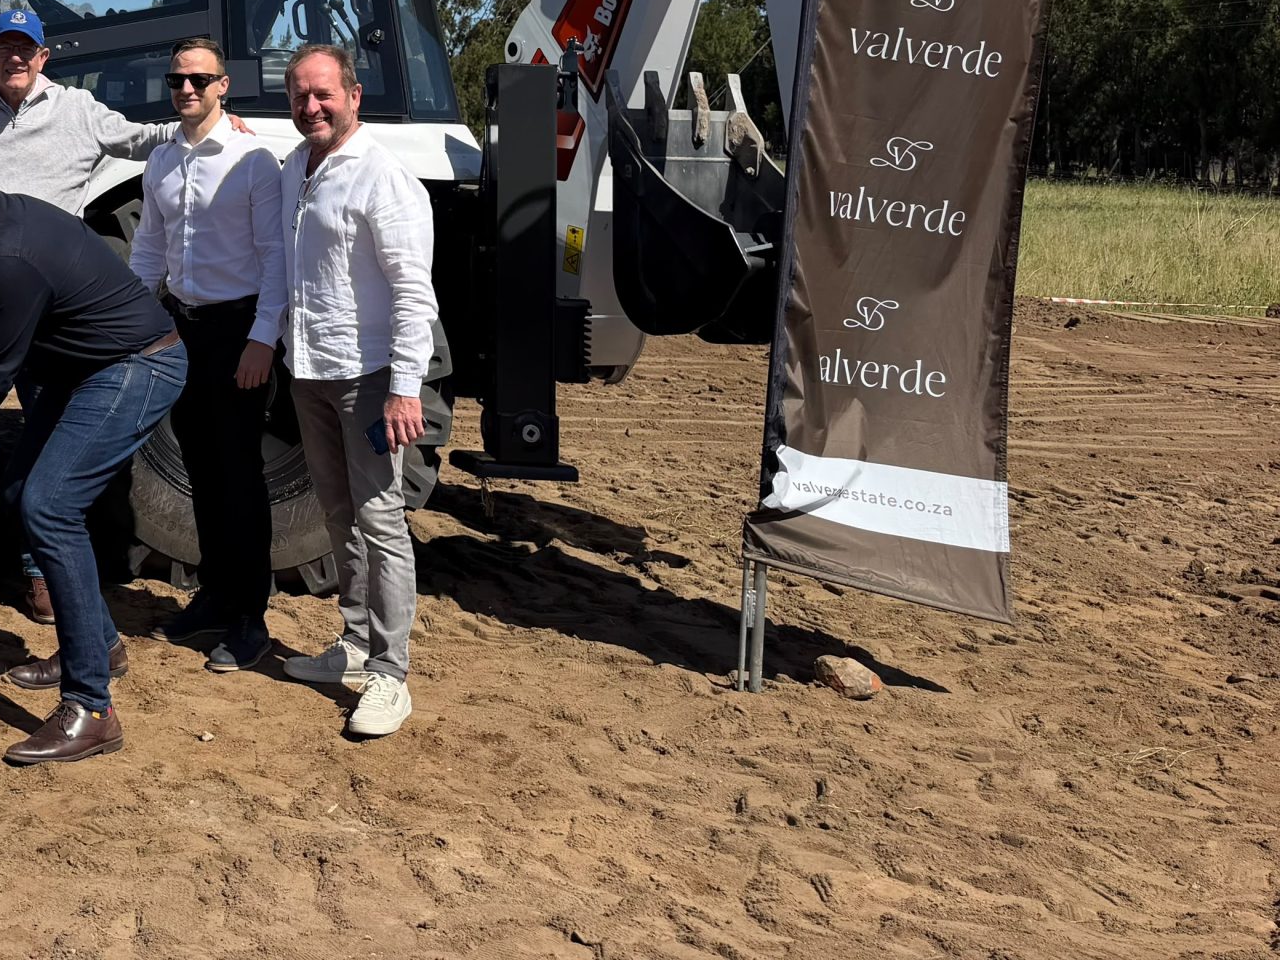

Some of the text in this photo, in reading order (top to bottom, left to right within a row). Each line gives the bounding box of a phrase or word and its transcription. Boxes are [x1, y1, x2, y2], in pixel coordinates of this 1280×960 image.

[850, 27, 1003, 78] valverde
[829, 186, 966, 236] valverde
[819, 348, 946, 398] alverde
